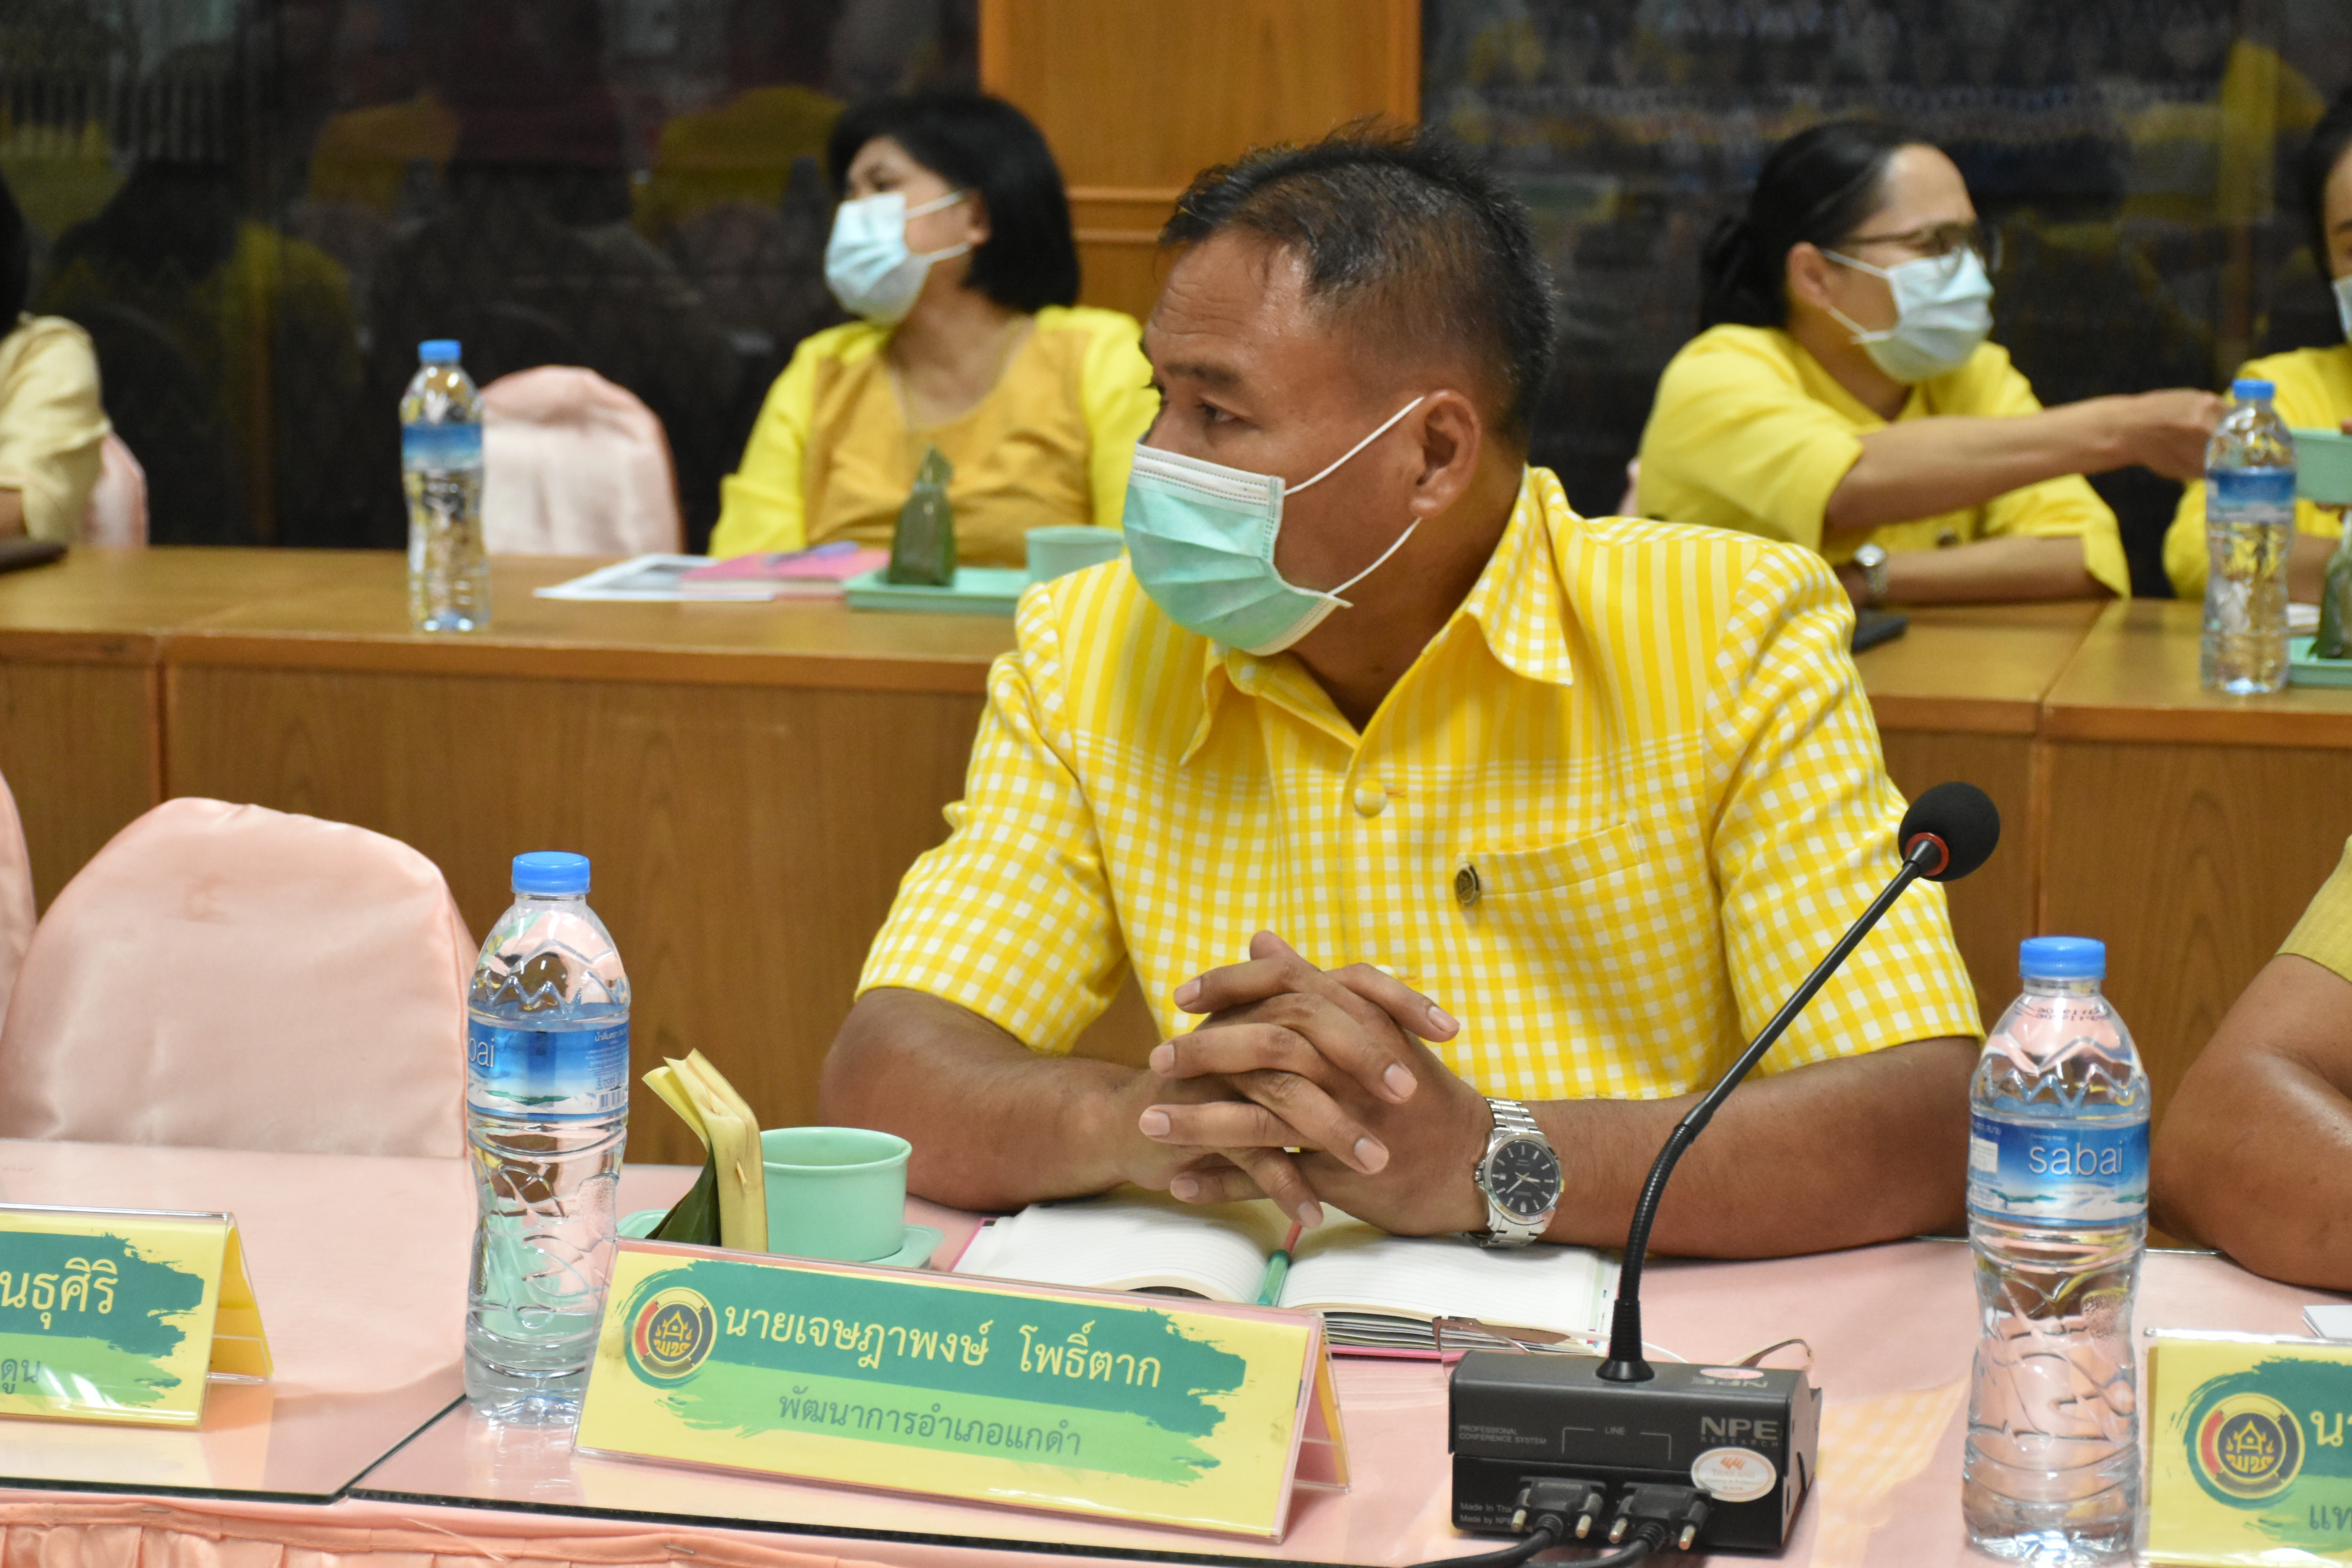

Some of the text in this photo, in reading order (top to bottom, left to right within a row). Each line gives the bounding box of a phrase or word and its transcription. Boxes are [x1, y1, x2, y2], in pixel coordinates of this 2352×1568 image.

[2029, 1140, 2123, 1175] sabai
[0, 1257, 118, 1330] นธุศิริ
[725, 1306, 1161, 1387] นายเจษฎาพงษ์ โพธิ์ตาก
[779, 1385, 1081, 1455] พัฒนาการอำเภอแกดำ
[1701, 1416, 1778, 1440] NPE
[2310, 1411, 2352, 1447] น
[1459, 1425, 1517, 1435] PROFESSIONAL
[1459, 1432, 1547, 1445] CONFERENCE SYSTEM
[1605, 1426, 1625, 1435] LINE
[1700, 1436, 1779, 1447] RESEARCH
[1460, 1502, 1483, 1511] Made
[1460, 1515, 1481, 1523] Made
[1484, 1516, 1493, 1525] by
